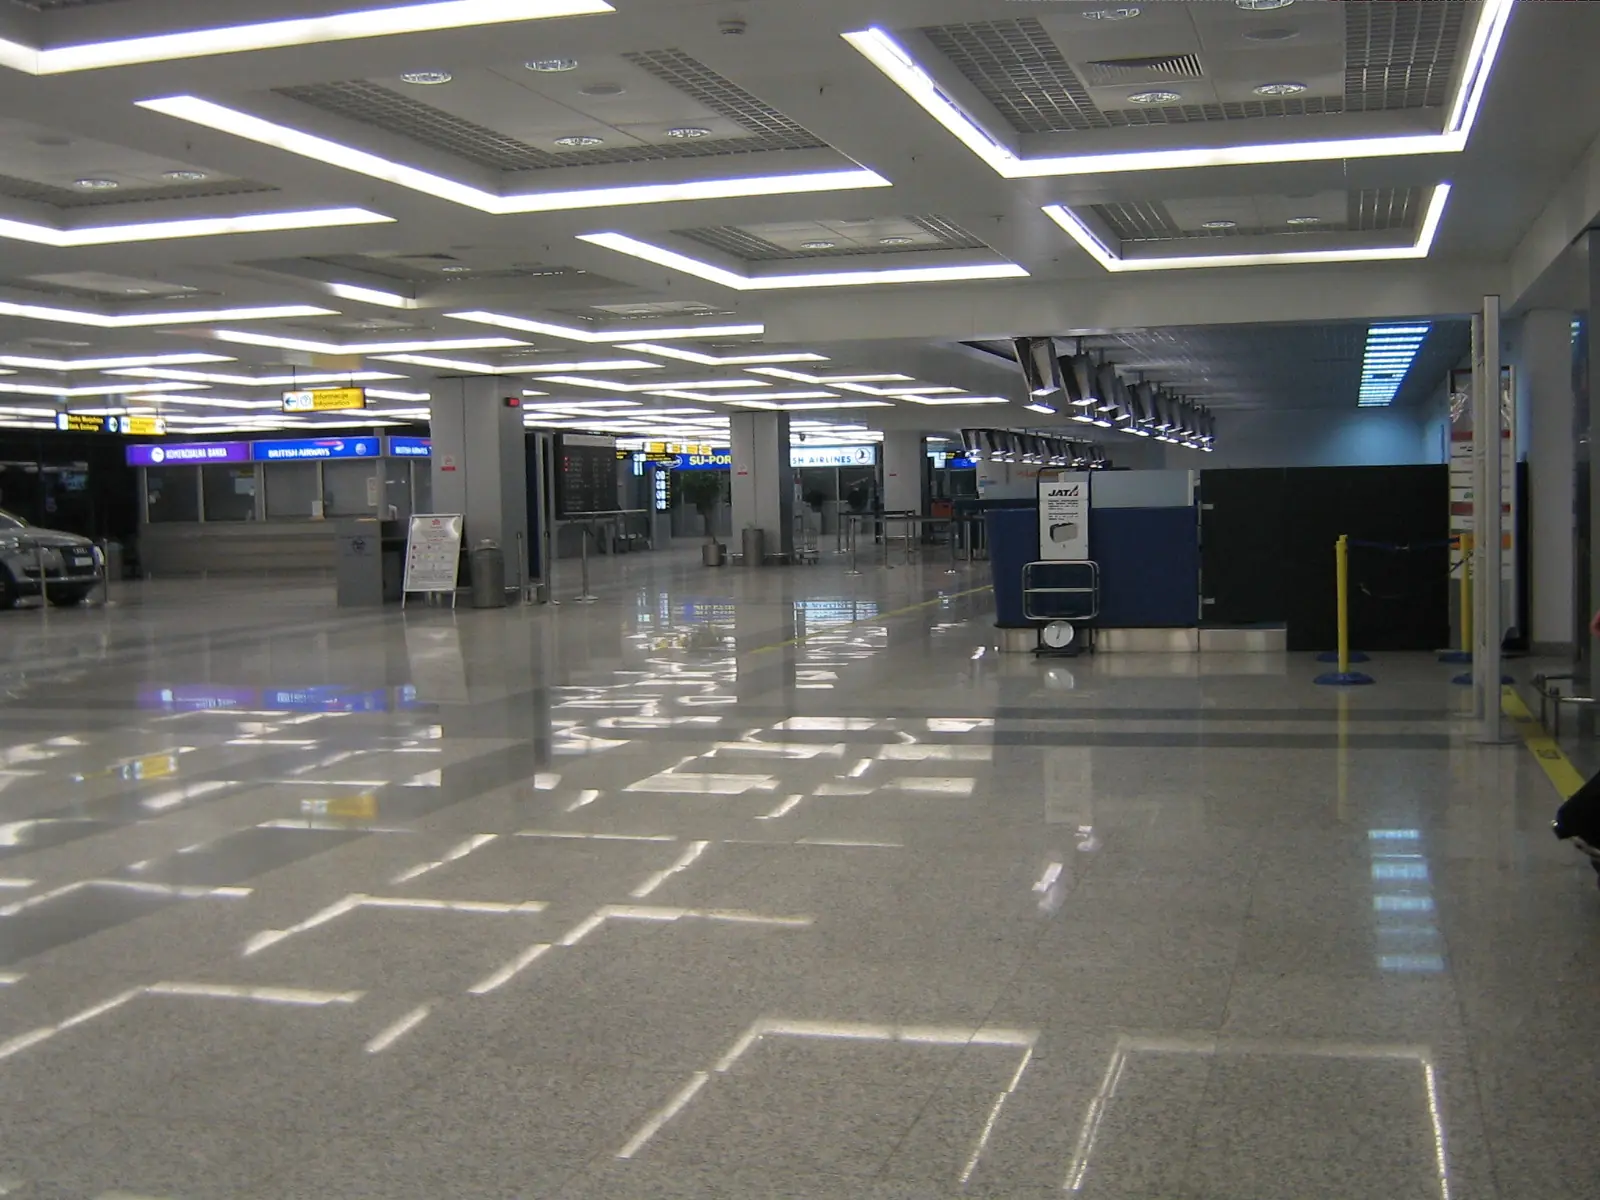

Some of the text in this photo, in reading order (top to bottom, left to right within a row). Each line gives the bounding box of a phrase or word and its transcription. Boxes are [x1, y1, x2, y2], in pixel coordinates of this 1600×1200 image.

[268, 448, 331, 459] BRITISH AIRWAYS
[809, 455, 852, 464] AIRLINES
